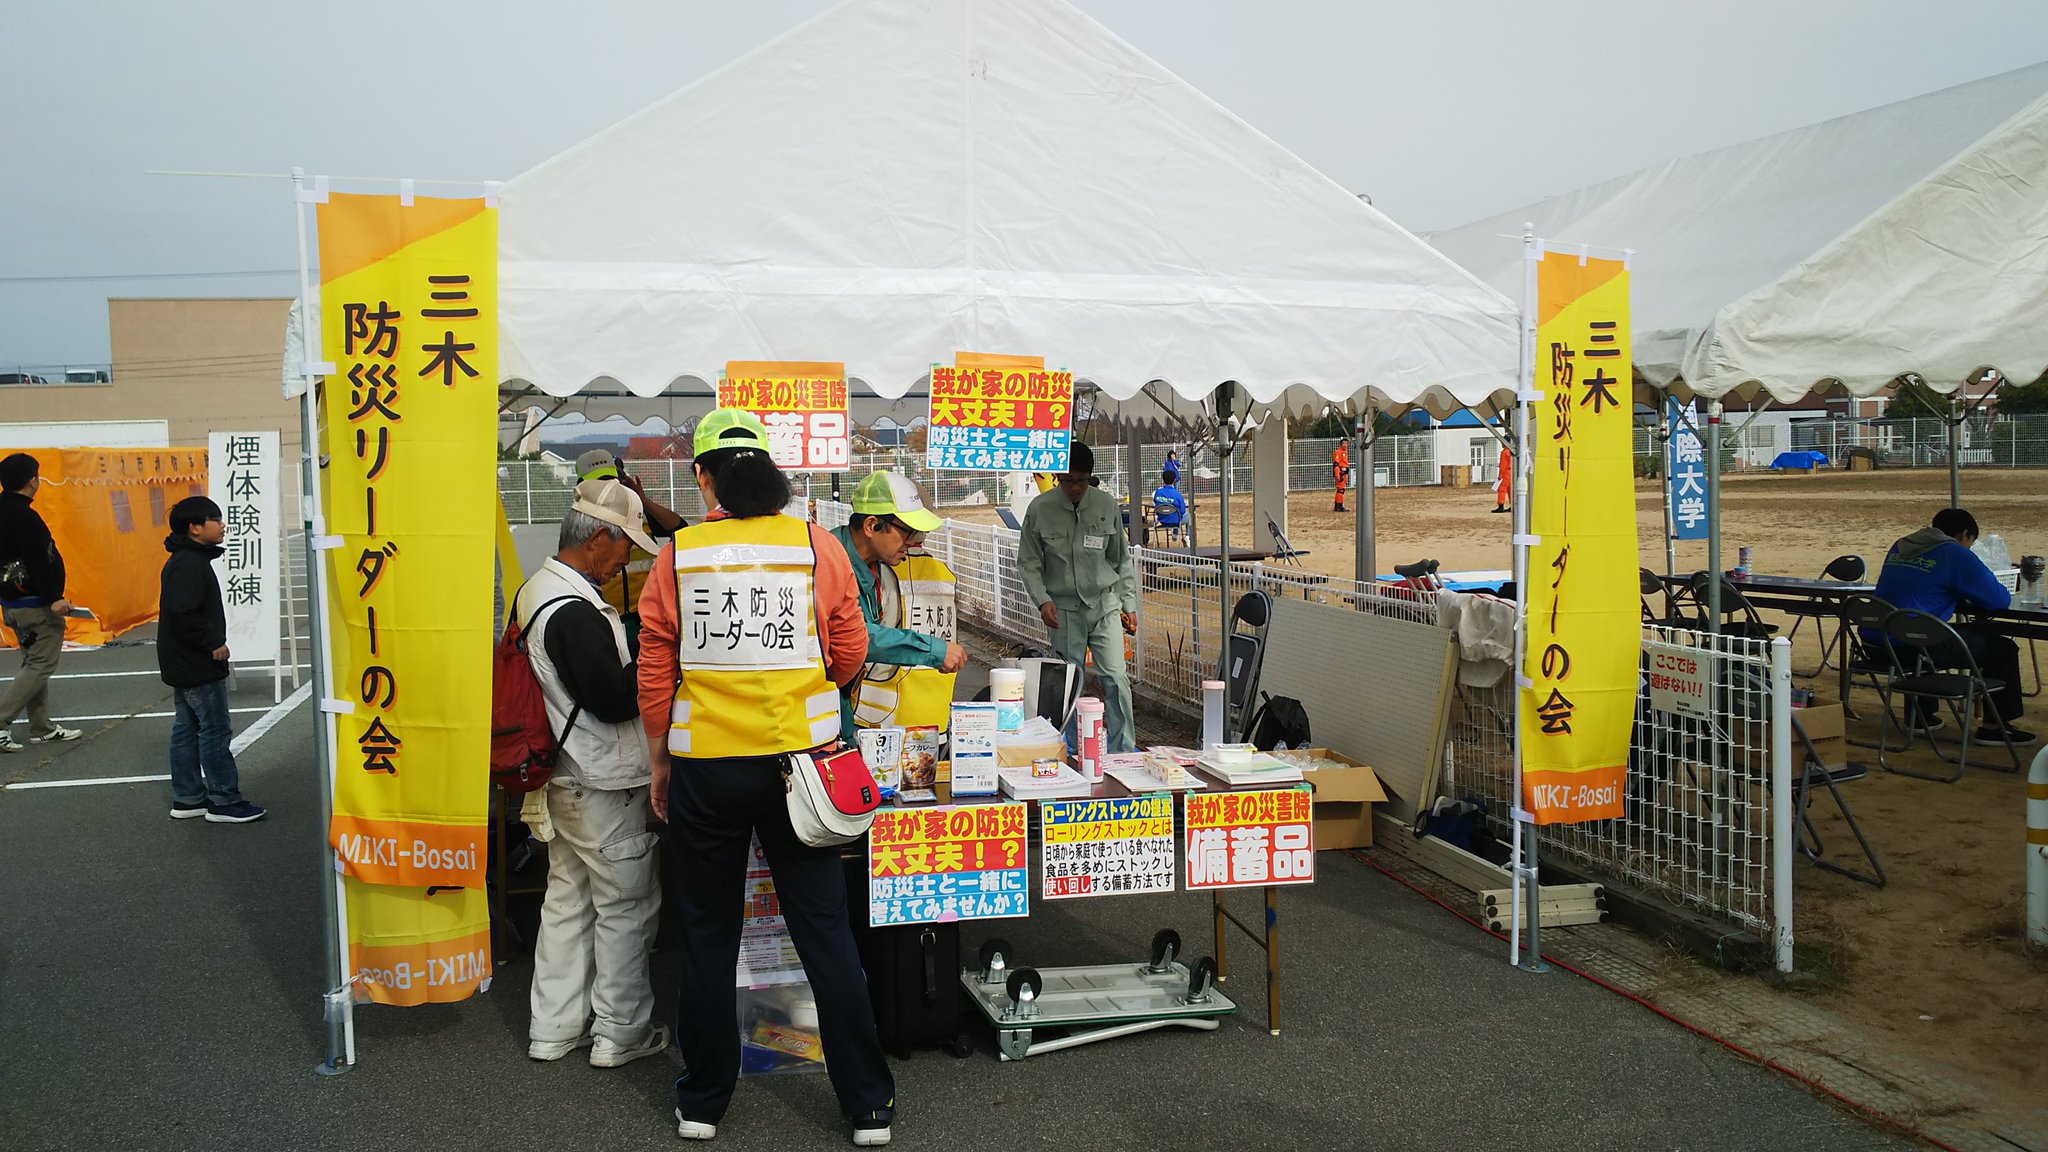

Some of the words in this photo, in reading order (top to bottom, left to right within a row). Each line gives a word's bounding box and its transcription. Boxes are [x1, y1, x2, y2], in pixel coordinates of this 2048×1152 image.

[418, 274, 481, 388] 三木
[932, 367, 1072, 400] 我が家の防災
[1580, 321, 1621, 414] 三木
[719, 378, 847, 409] 我が家の災害時
[748, 412, 847, 466] 蓄品
[930, 426, 1065, 449] 防災士と一緒に
[225, 435, 262, 606] 煙体験訓練
[343, 300, 402, 775] 防災リーダーの会
[1537, 341, 1575, 735] 防災リーダーの会
[694, 619, 795, 650] リーダーの会
[1656, 654, 1697, 674] ここでは
[872, 806, 1025, 843] 我が家の防災
[1187, 791, 1311, 826] 我が家の災害時
[1045, 819, 1172, 841] ローリングストックとは
[339, 832, 477, 871] MIKI-Bosai
[1046, 838, 1173, 862] 日頃から家庭で使っている食べなれた
[1046, 856, 1173, 878] 食品を多めにストックし
[1188, 824, 1312, 885] 備蓄品
[872, 871, 1021, 899] 防災士と一緒に
